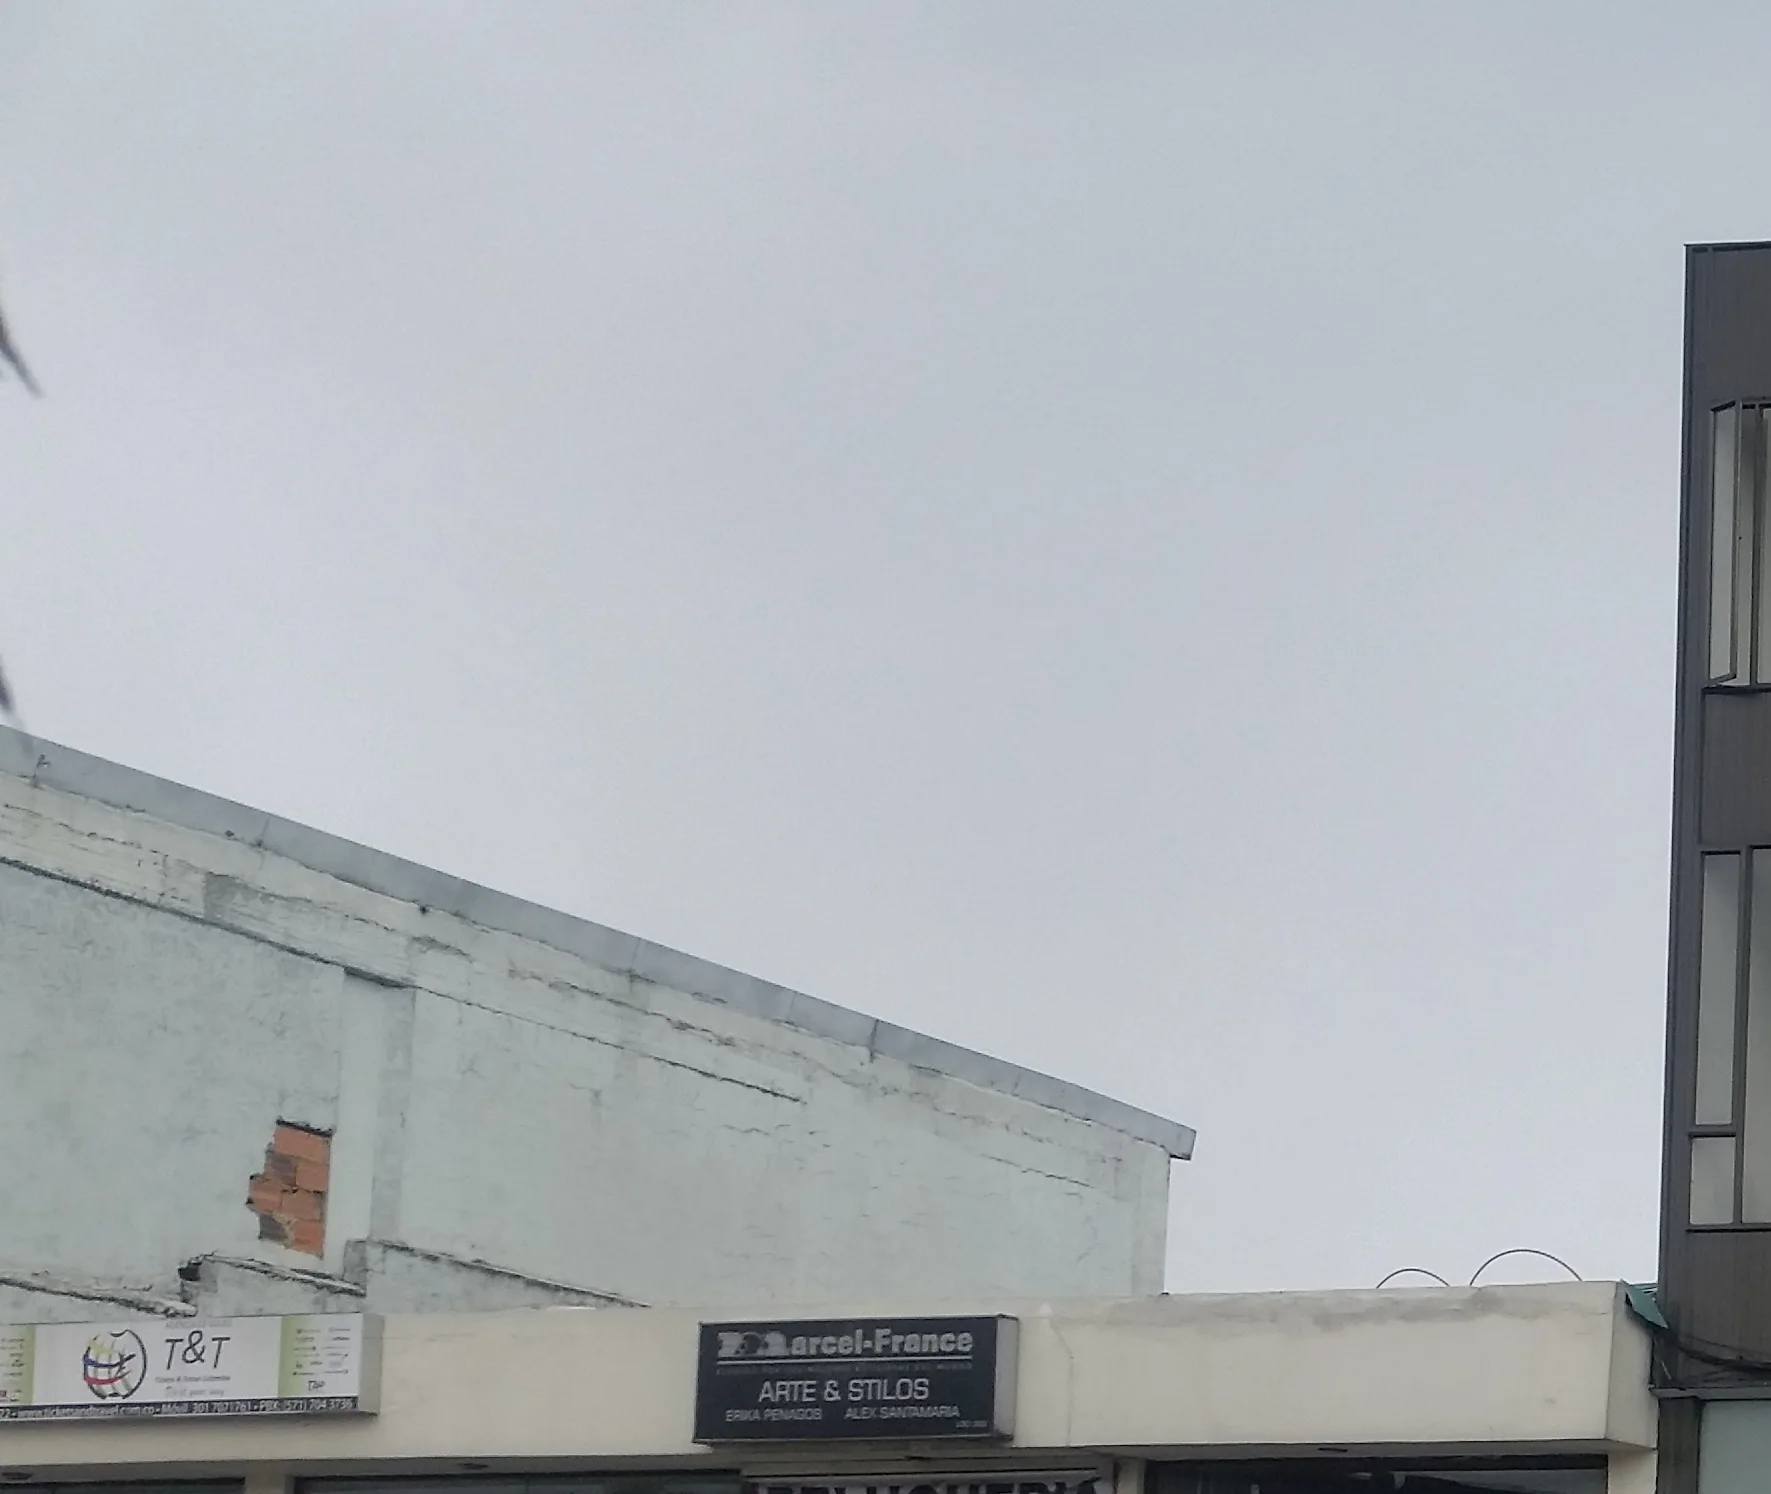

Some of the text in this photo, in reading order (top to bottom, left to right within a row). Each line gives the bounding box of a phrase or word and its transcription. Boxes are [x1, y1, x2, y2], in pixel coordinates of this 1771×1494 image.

[165, 1330, 231, 1371] T&T
[758, 1378, 930, 1402] ARTE & STILOS
[844, 1406, 876, 1420] ALEX
[880, 1405, 960, 1419] SANTAMARIA
